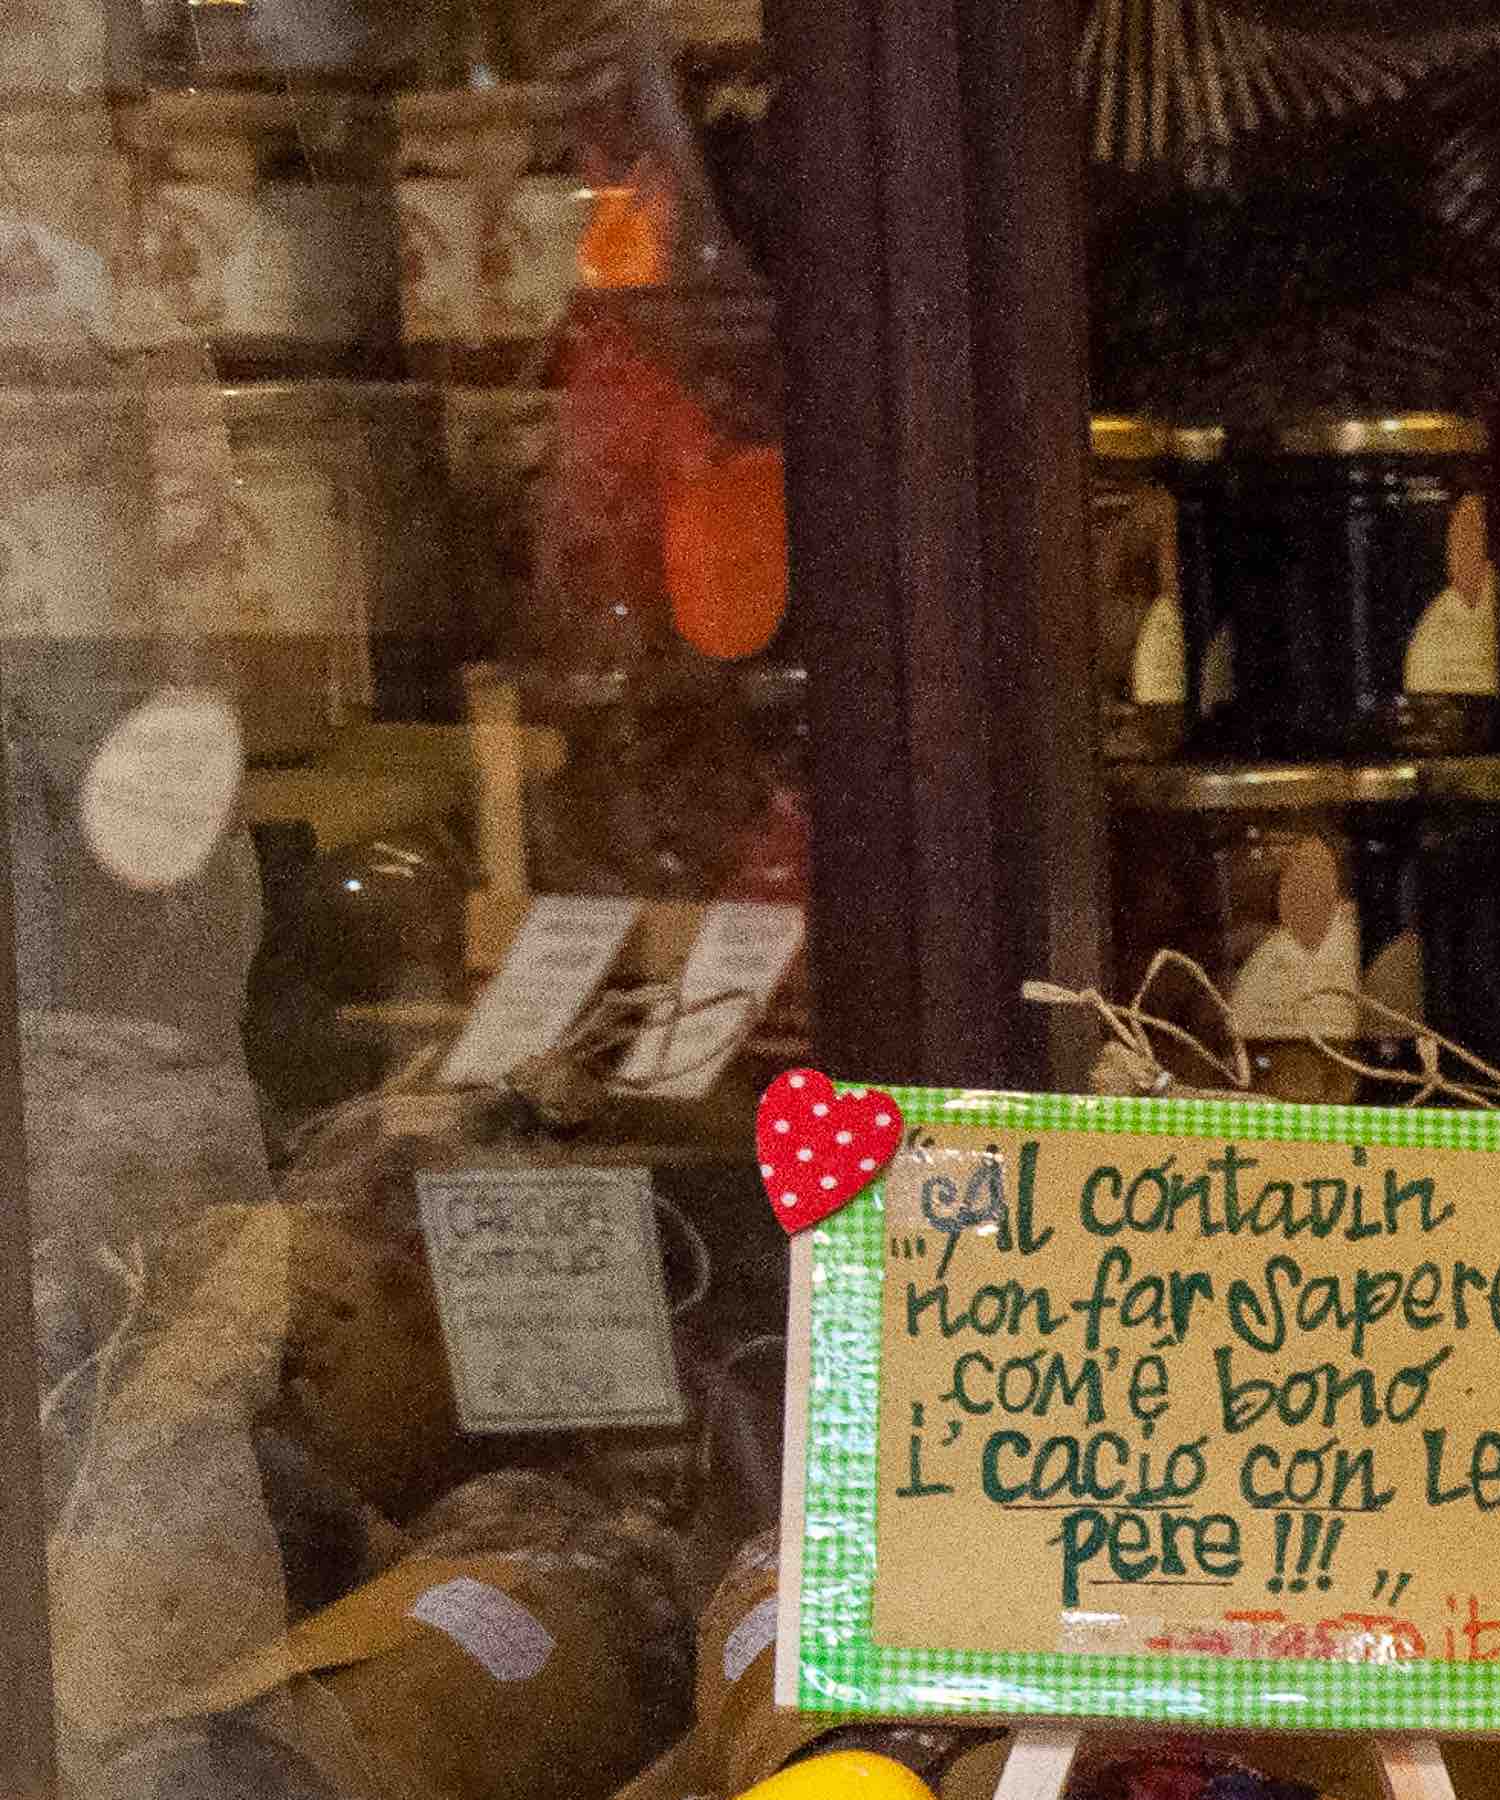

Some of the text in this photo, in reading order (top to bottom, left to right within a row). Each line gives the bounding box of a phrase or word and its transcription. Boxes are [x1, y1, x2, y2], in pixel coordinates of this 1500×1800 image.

[906, 1271, 1064, 1338] non
[1070, 1246, 1214, 1352] far
[1241, 1428, 1395, 1508] con
